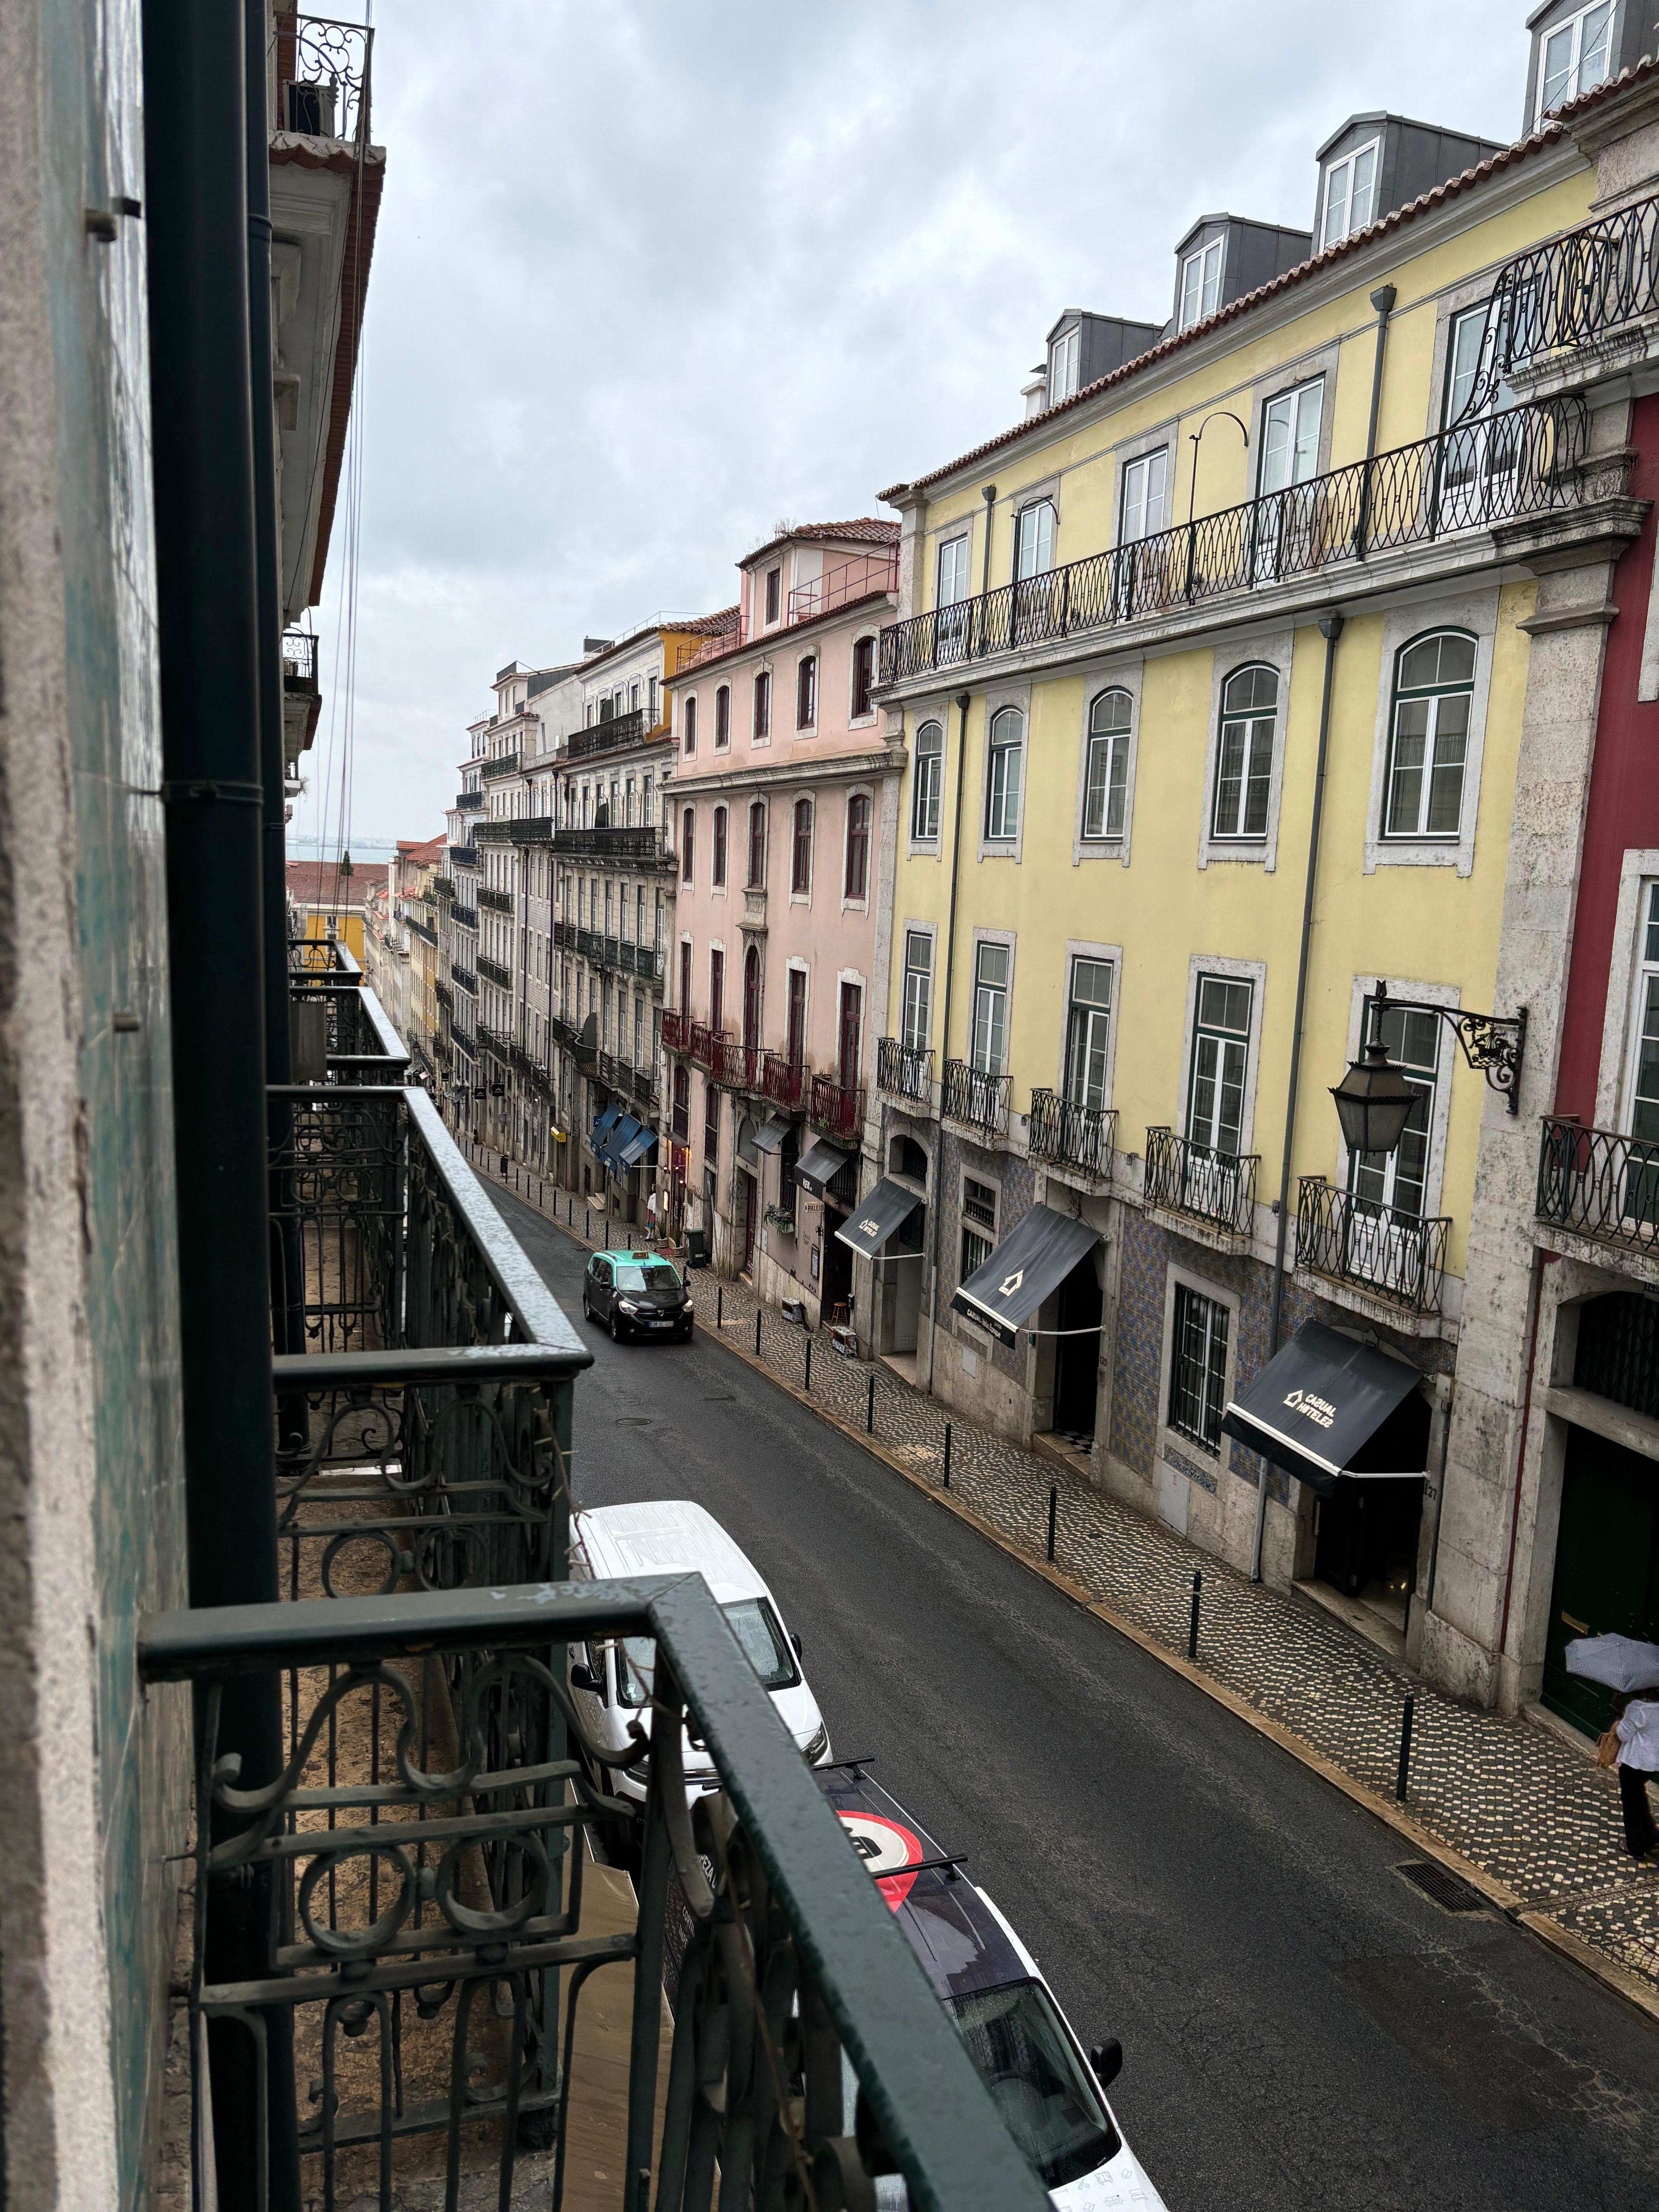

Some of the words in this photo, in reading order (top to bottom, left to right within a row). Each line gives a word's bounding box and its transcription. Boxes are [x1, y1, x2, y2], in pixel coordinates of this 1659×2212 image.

[1296, 1402, 1334, 1428] HOTELES
[1305, 1394, 1336, 1417] CASUAL
[1425, 1483, 1437, 1500] 127
